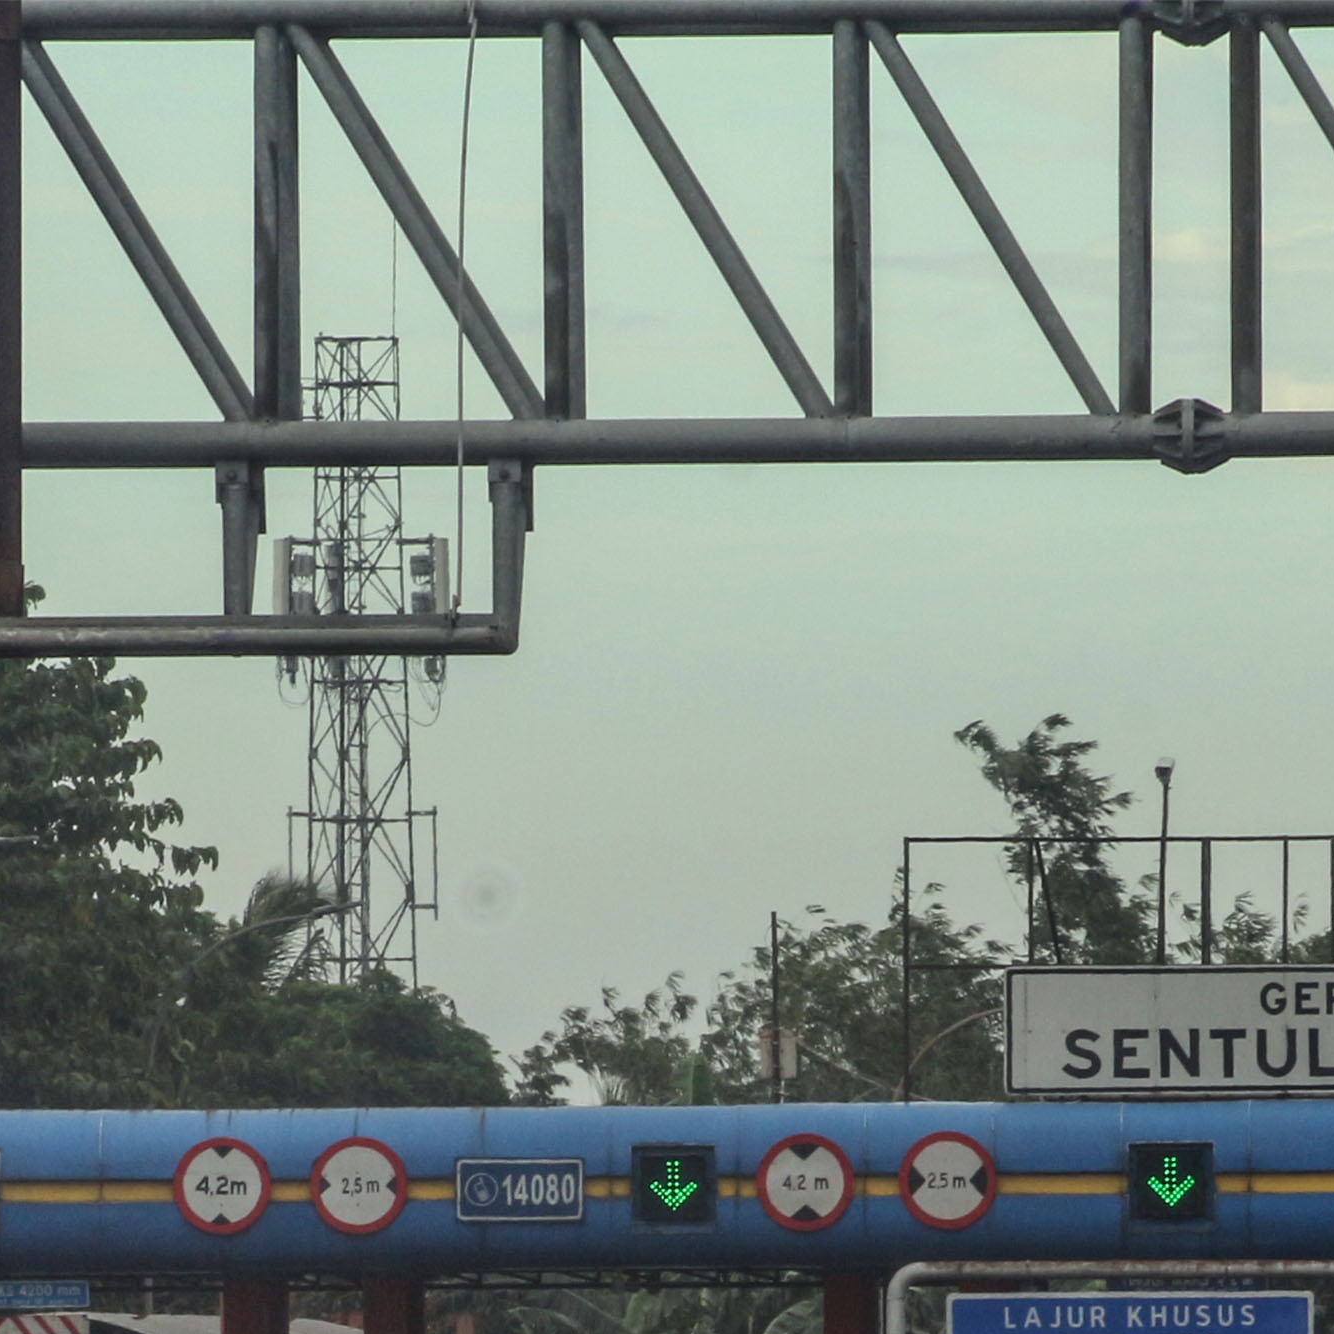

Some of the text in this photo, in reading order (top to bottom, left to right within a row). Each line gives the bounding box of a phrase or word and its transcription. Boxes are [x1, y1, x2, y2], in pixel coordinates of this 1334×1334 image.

[500, 1173, 576, 1207] 14080
[1004, 1304, 1256, 1329] LAJUR KHUSUS
